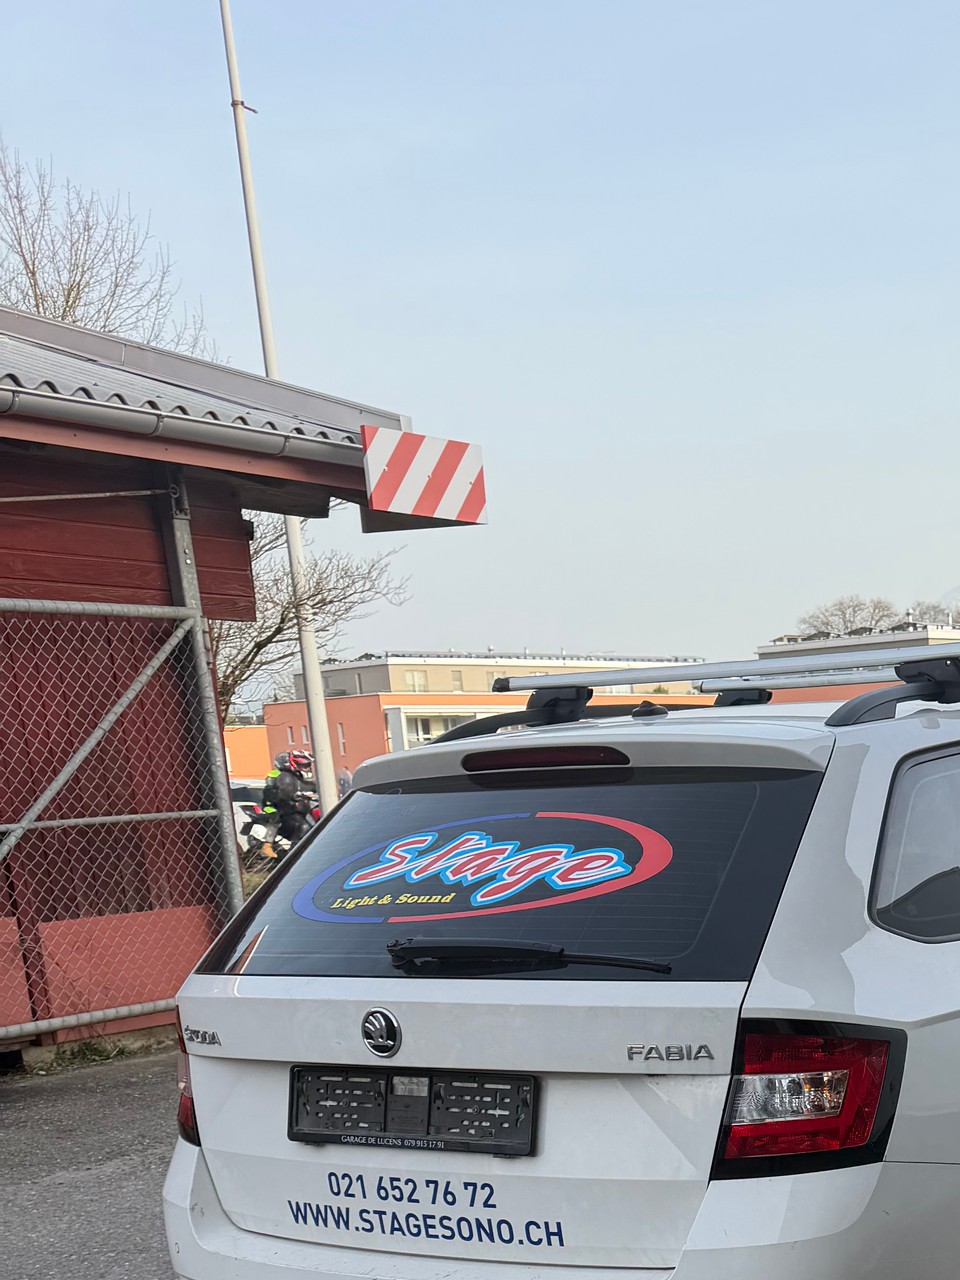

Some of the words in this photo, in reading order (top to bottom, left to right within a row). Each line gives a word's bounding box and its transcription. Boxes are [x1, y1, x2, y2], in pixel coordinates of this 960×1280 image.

[343, 831, 633, 907] Stage
[330, 895, 378, 909] Light
[378, 894, 392, 905] &
[395, 893, 456, 905] Sound
[627, 1044, 715, 1061] FABIA
[341, 1135, 366, 1144] GARAGE
[377, 1138, 402, 1146] LUCENS
[416, 1140, 427, 1148] 915
[327, 1171, 367, 1199] 021
[376, 1176, 420, 1204] 652
[425, 1180, 457, 1206] 76
[463, 1182, 497, 1209] 72
[287, 1200, 565, 1247] WWW.STAGESONO.CH
